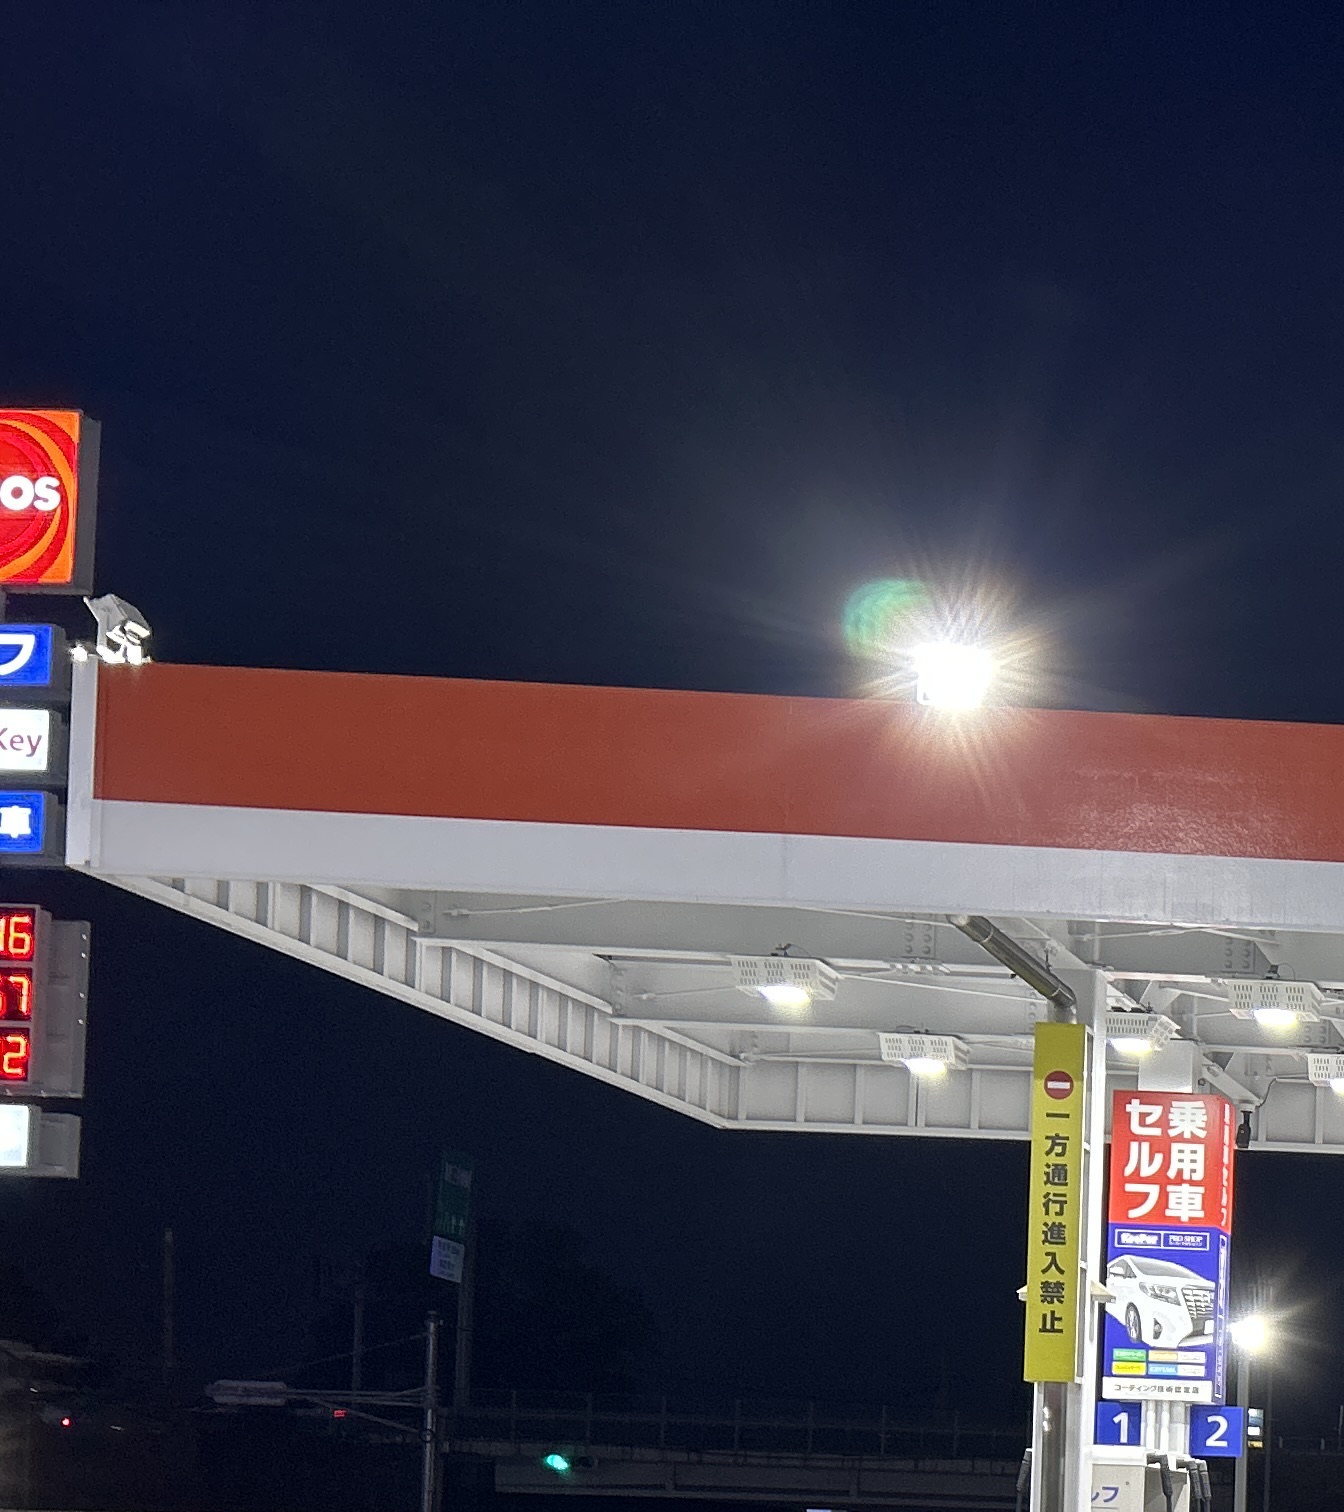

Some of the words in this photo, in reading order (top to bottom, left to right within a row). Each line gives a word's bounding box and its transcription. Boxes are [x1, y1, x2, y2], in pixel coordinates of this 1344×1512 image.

[1123, 1098, 1164, 1219] セルフ
[1165, 1099, 1207, 1222] 乗用車
[1038, 1113, 1070, 1334] 一方通行進入禁止
[1112, 1412, 1129, 1444] 1
[1205, 1415, 1228, 1447] 2
